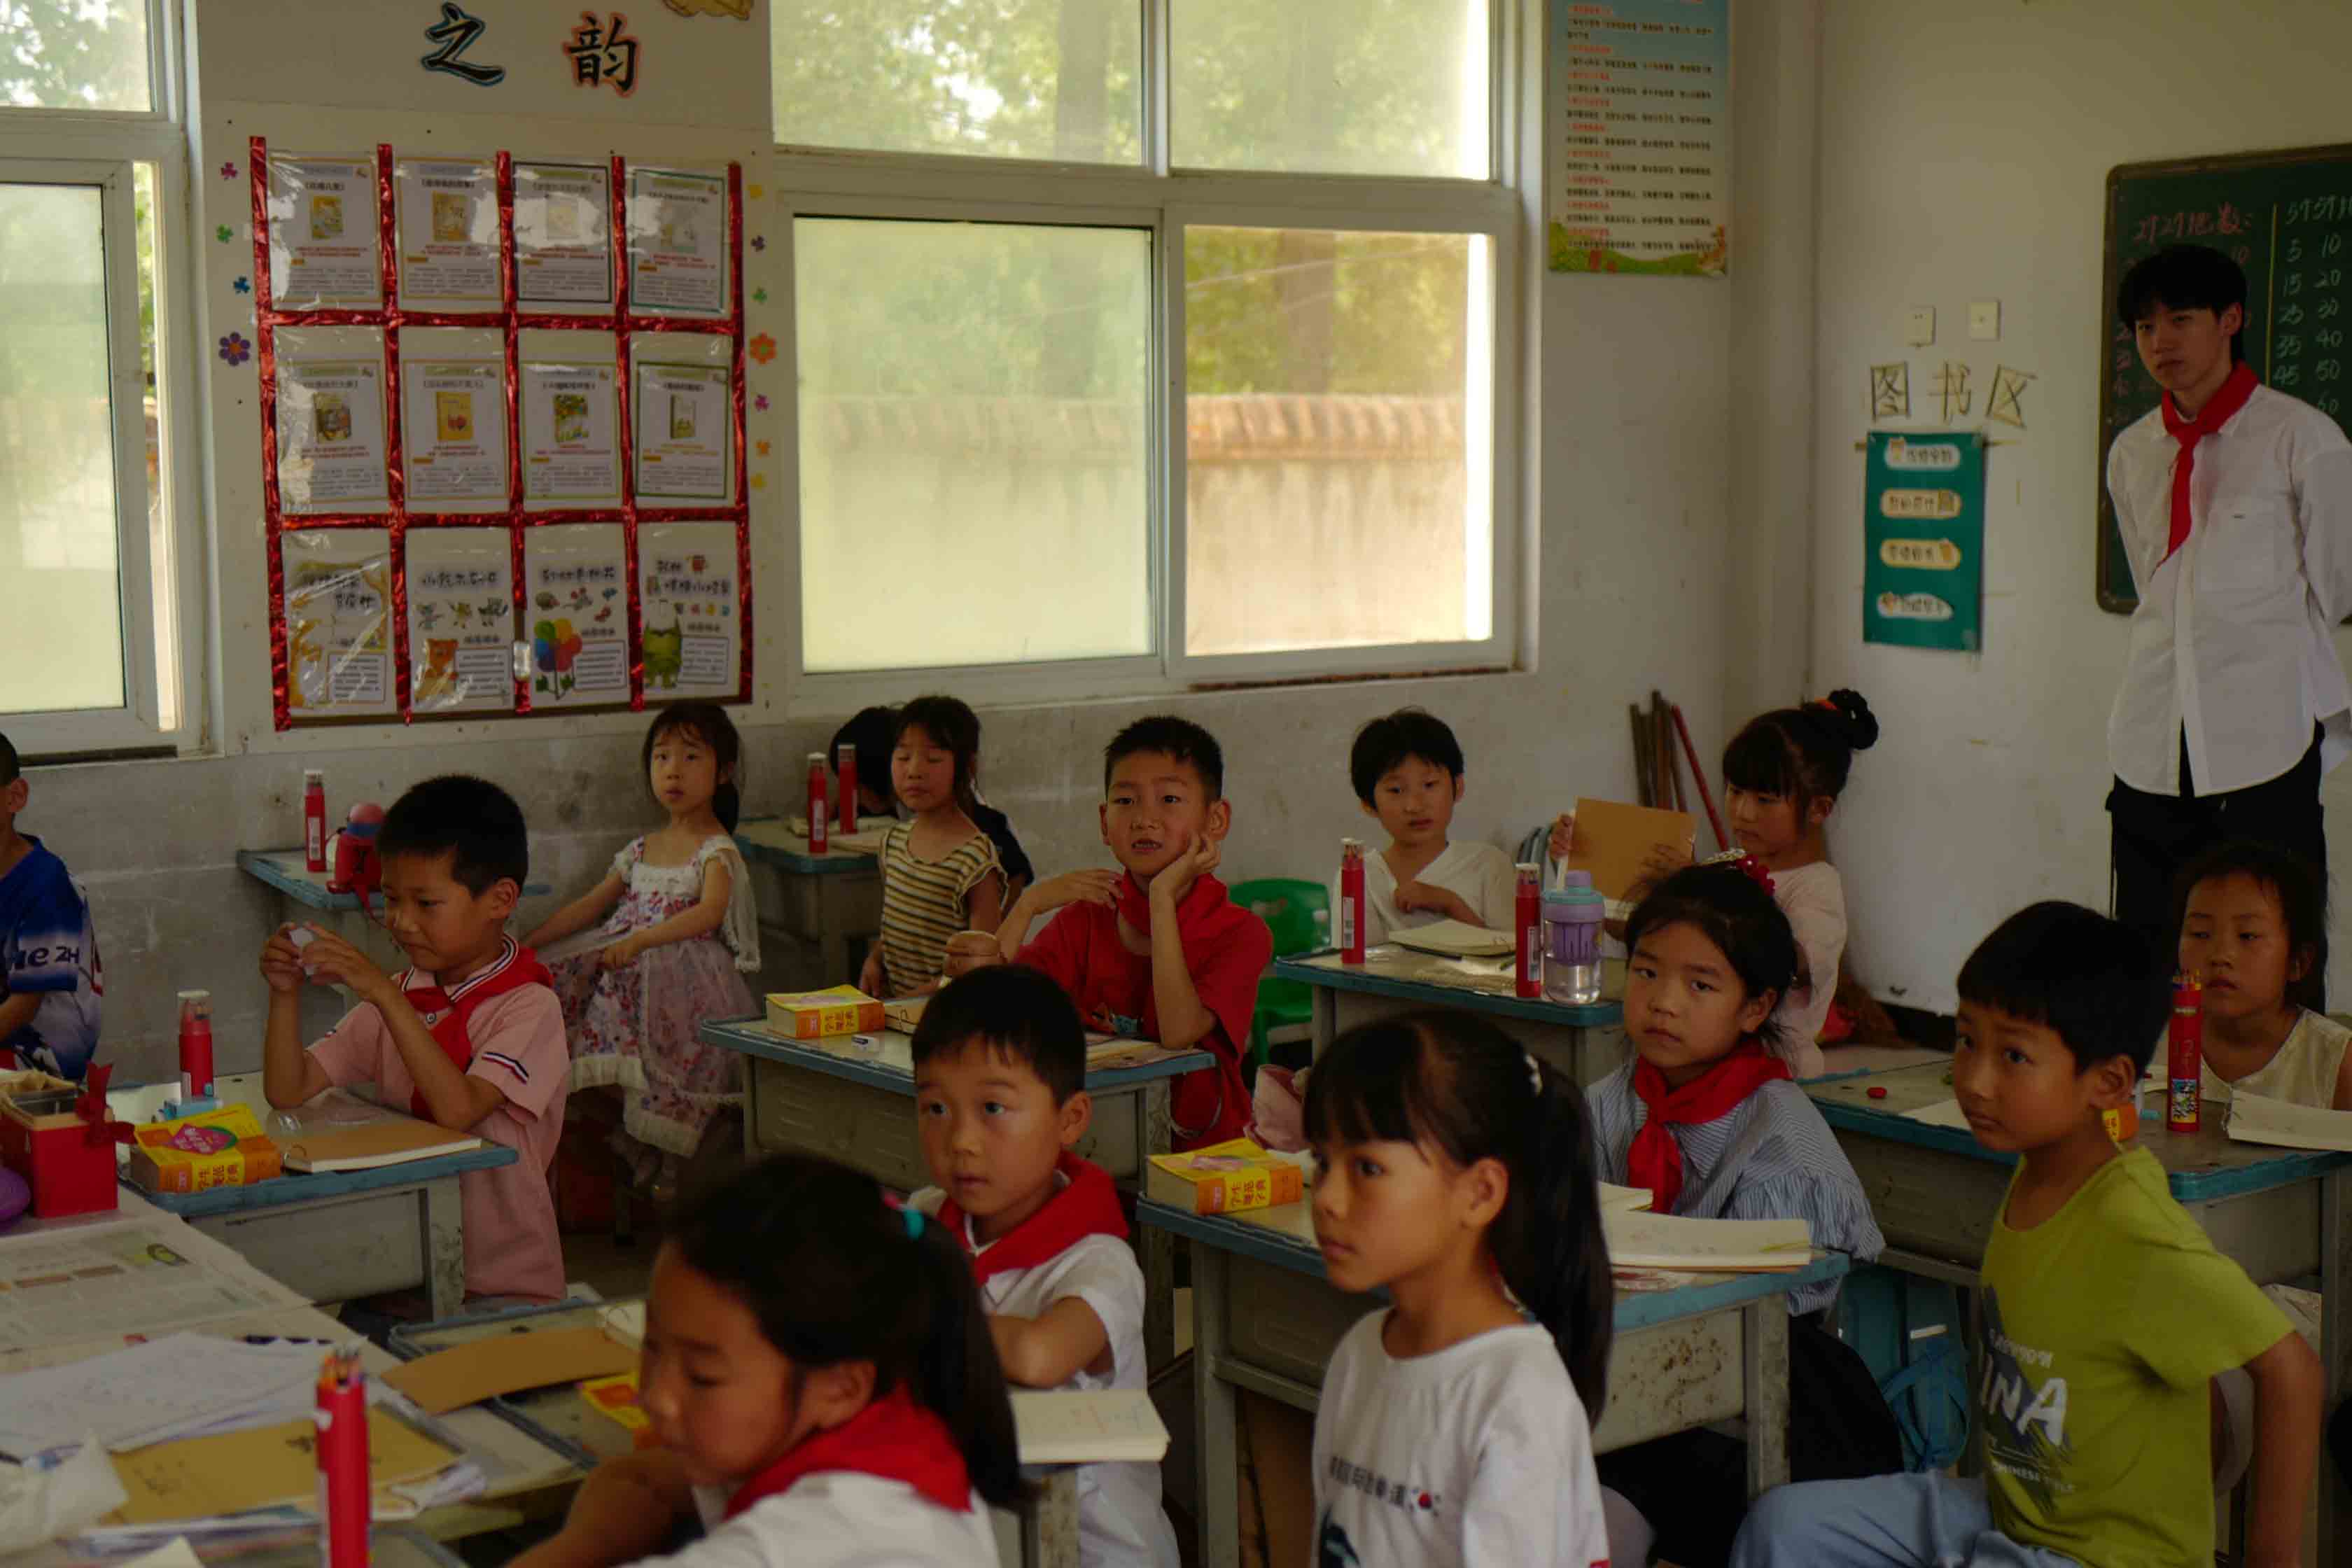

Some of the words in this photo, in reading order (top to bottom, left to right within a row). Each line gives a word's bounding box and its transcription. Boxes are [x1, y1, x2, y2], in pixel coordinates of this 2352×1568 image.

[2320, 232, 2342, 258] 10
[2282, 273, 2302, 298] 15
[2314, 269, 2342, 288] 20
[2318, 297, 2340, 320] 30
[2315, 328, 2343, 348] 40
[2315, 358, 2342, 382] 50
[1869, 360, 2038, 428] 图书区
